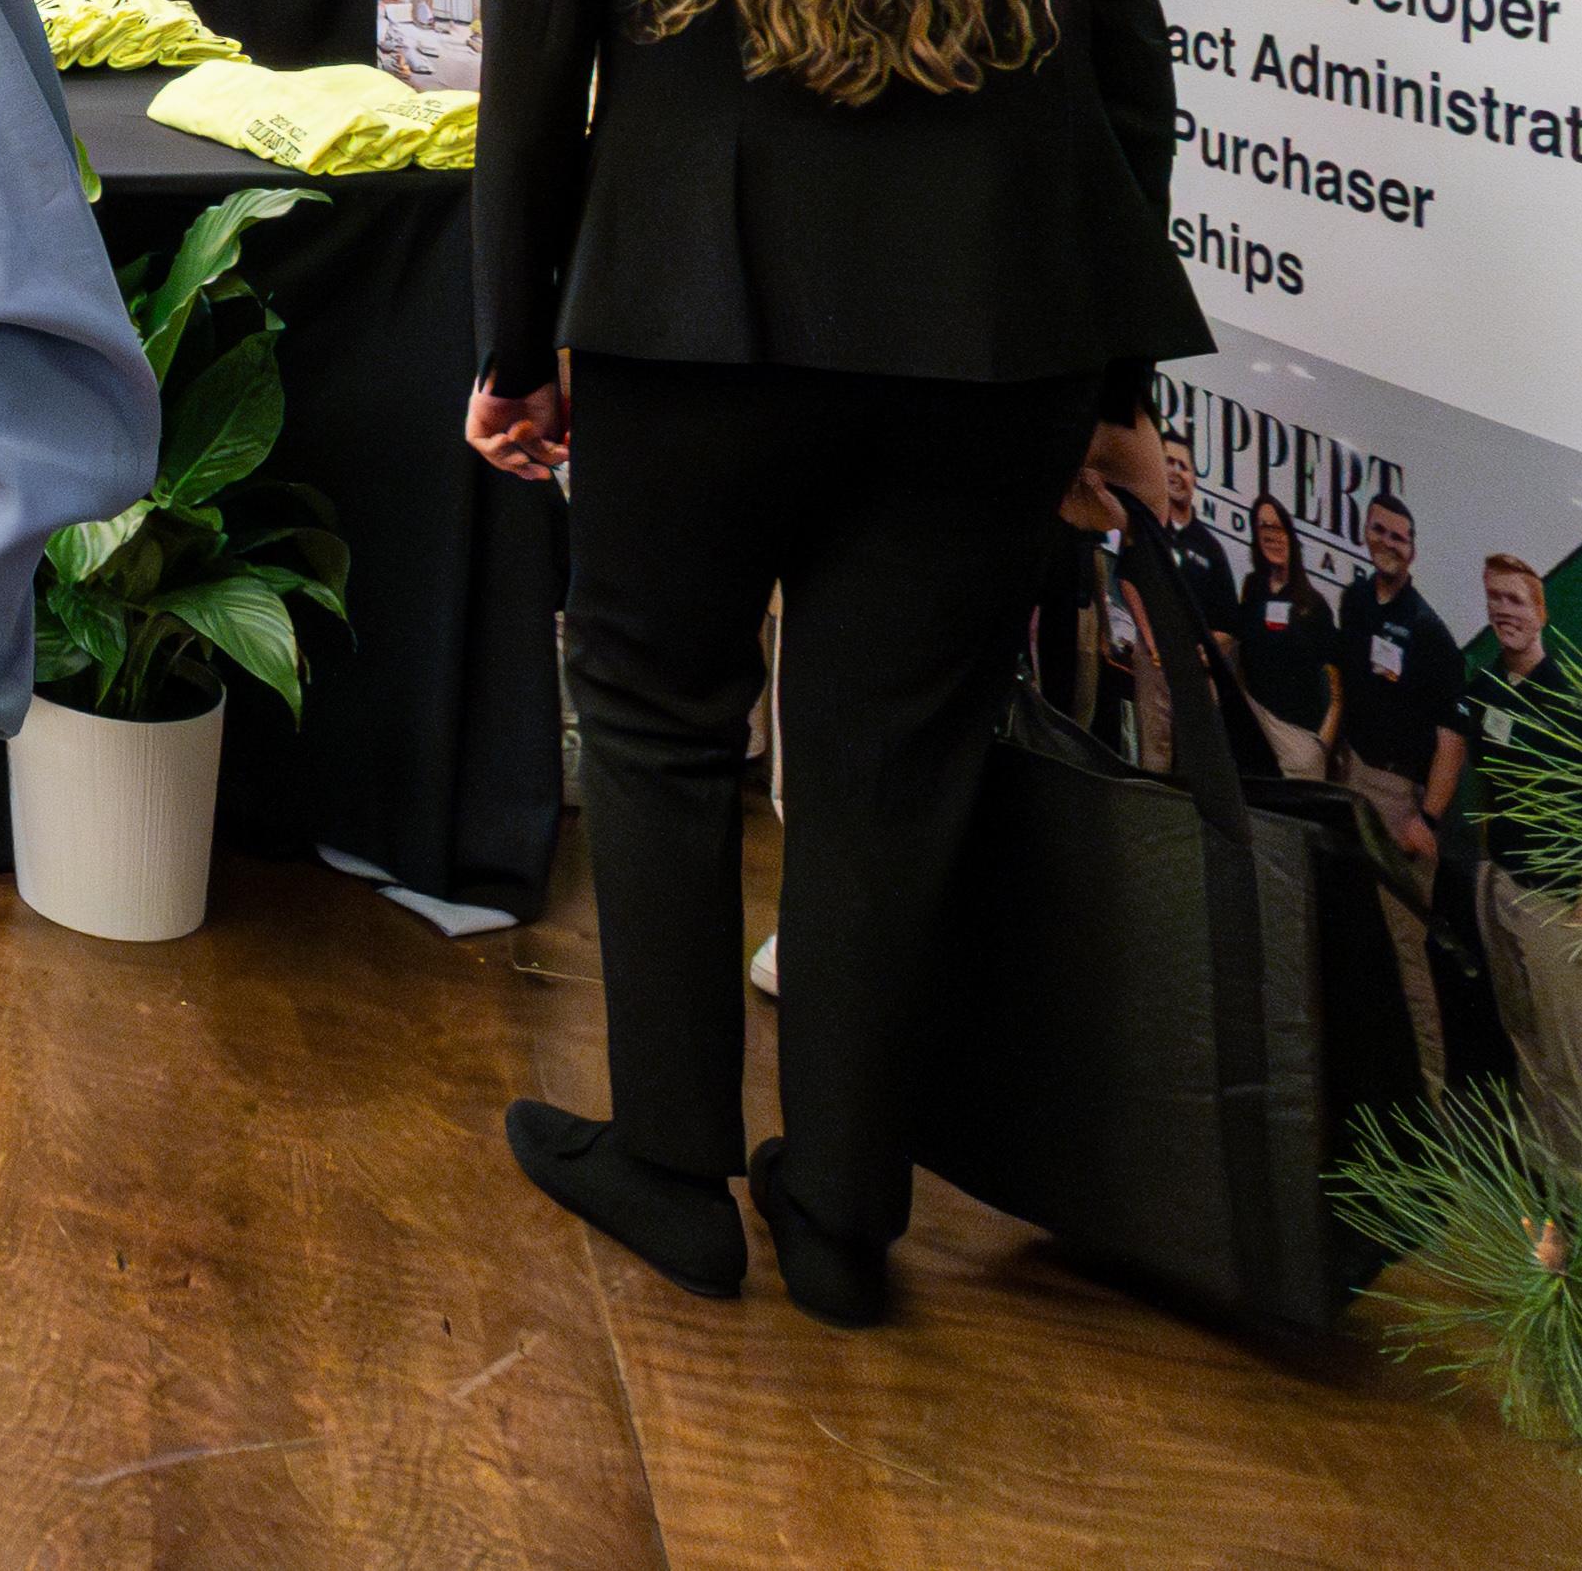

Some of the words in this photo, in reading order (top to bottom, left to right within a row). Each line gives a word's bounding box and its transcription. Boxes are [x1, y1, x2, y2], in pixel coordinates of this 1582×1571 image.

[1168, 25, 1236, 77] act
[1172, 108, 1435, 228] Purchaser
[1171, 214, 1304, 295] ships
